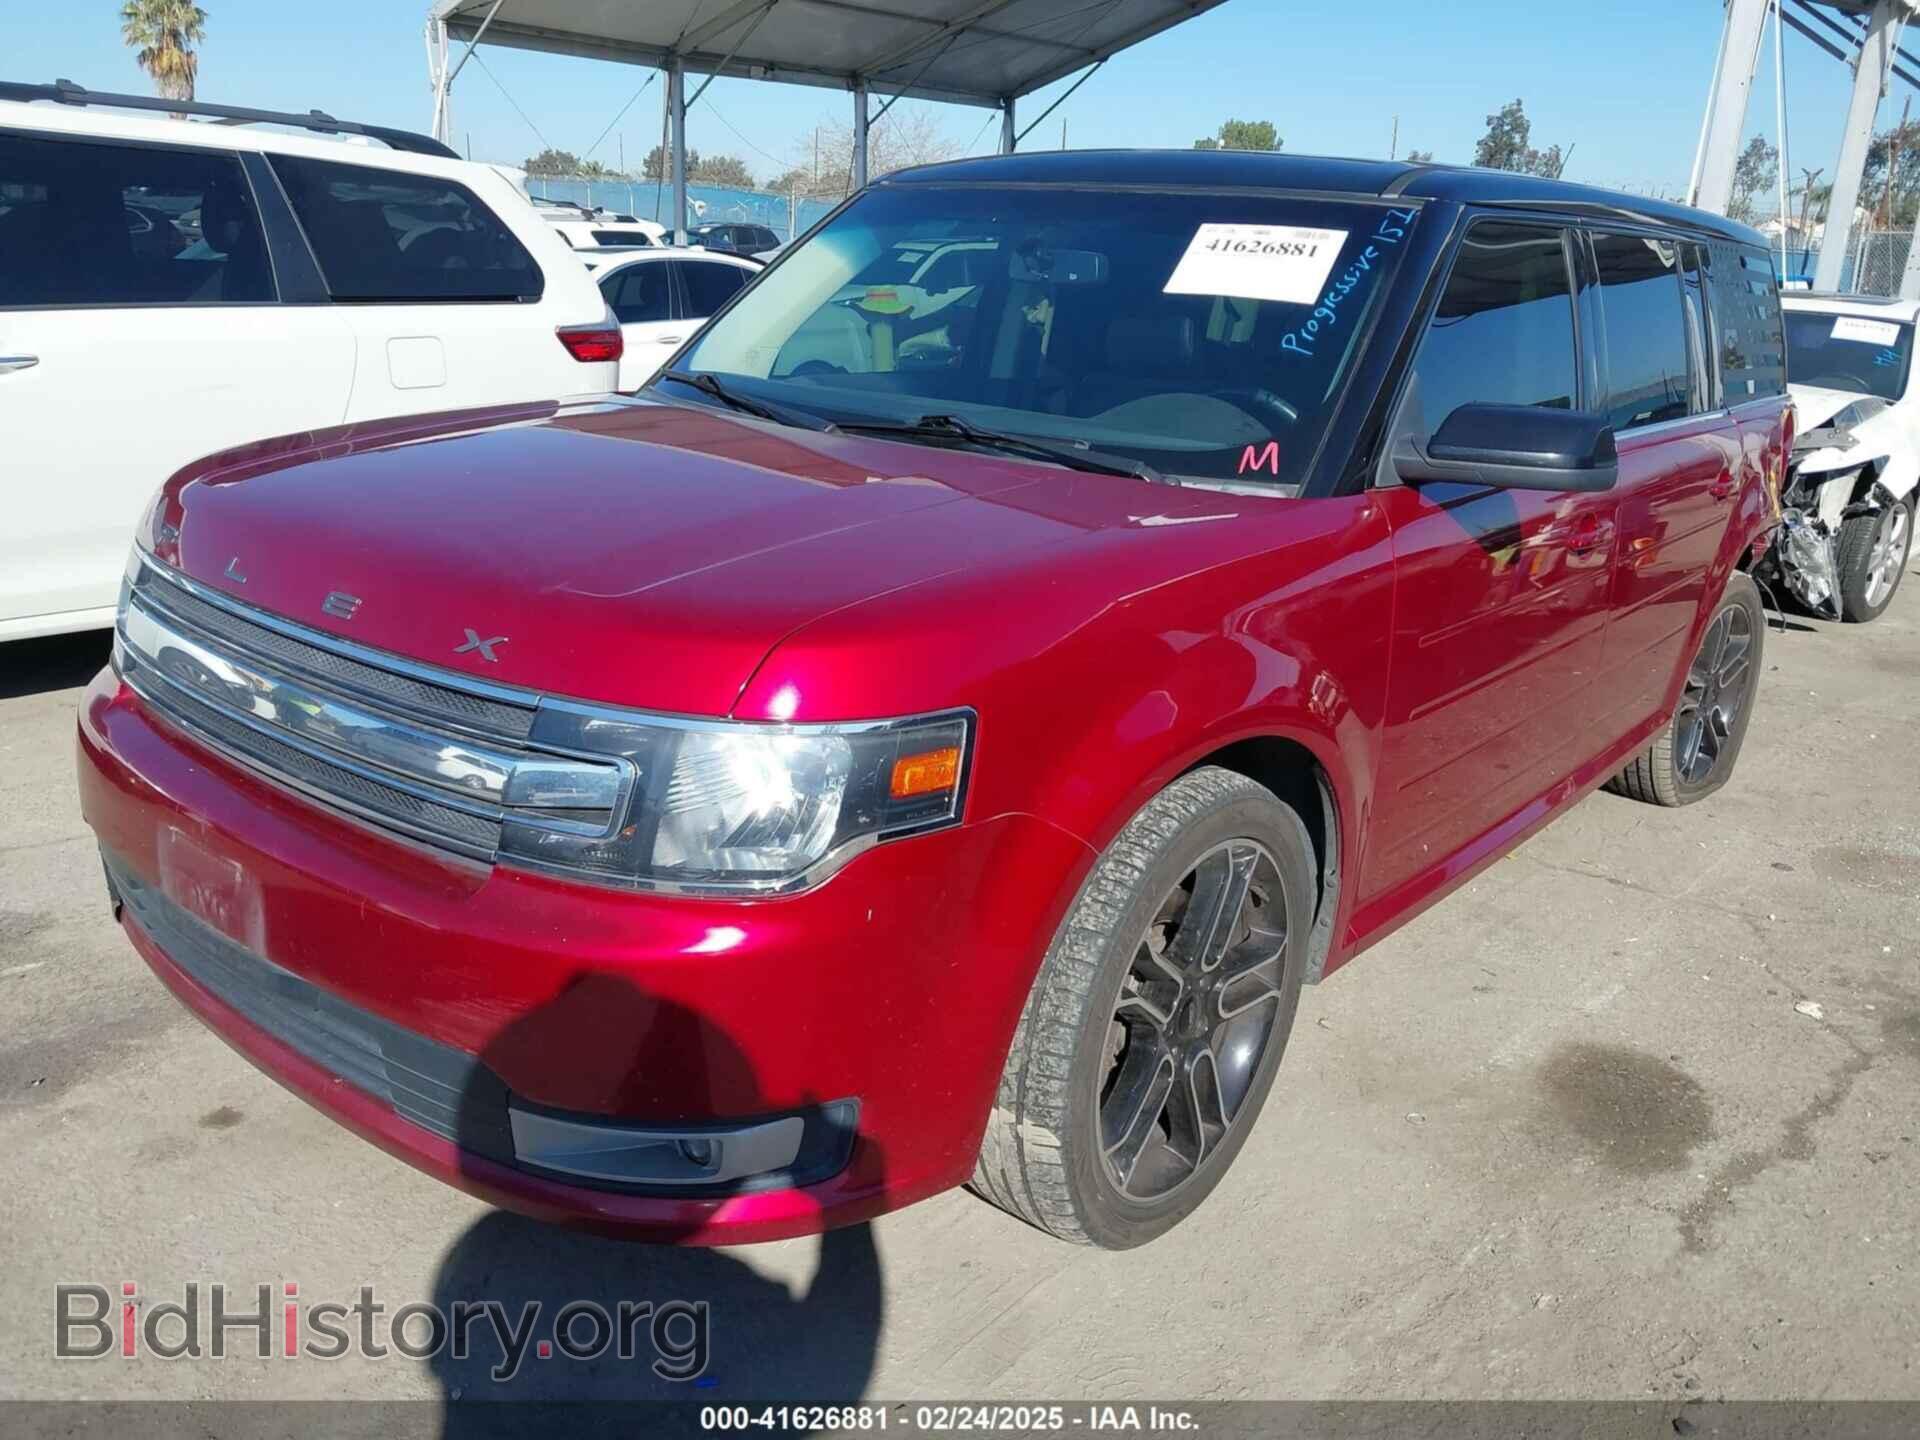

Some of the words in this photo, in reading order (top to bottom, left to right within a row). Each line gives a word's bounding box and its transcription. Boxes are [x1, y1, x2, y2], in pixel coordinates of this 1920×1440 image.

[1205, 238, 1319, 257] 41626881
[1281, 246, 1379, 355] Progressive
[1238, 441, 1279, 475] M
